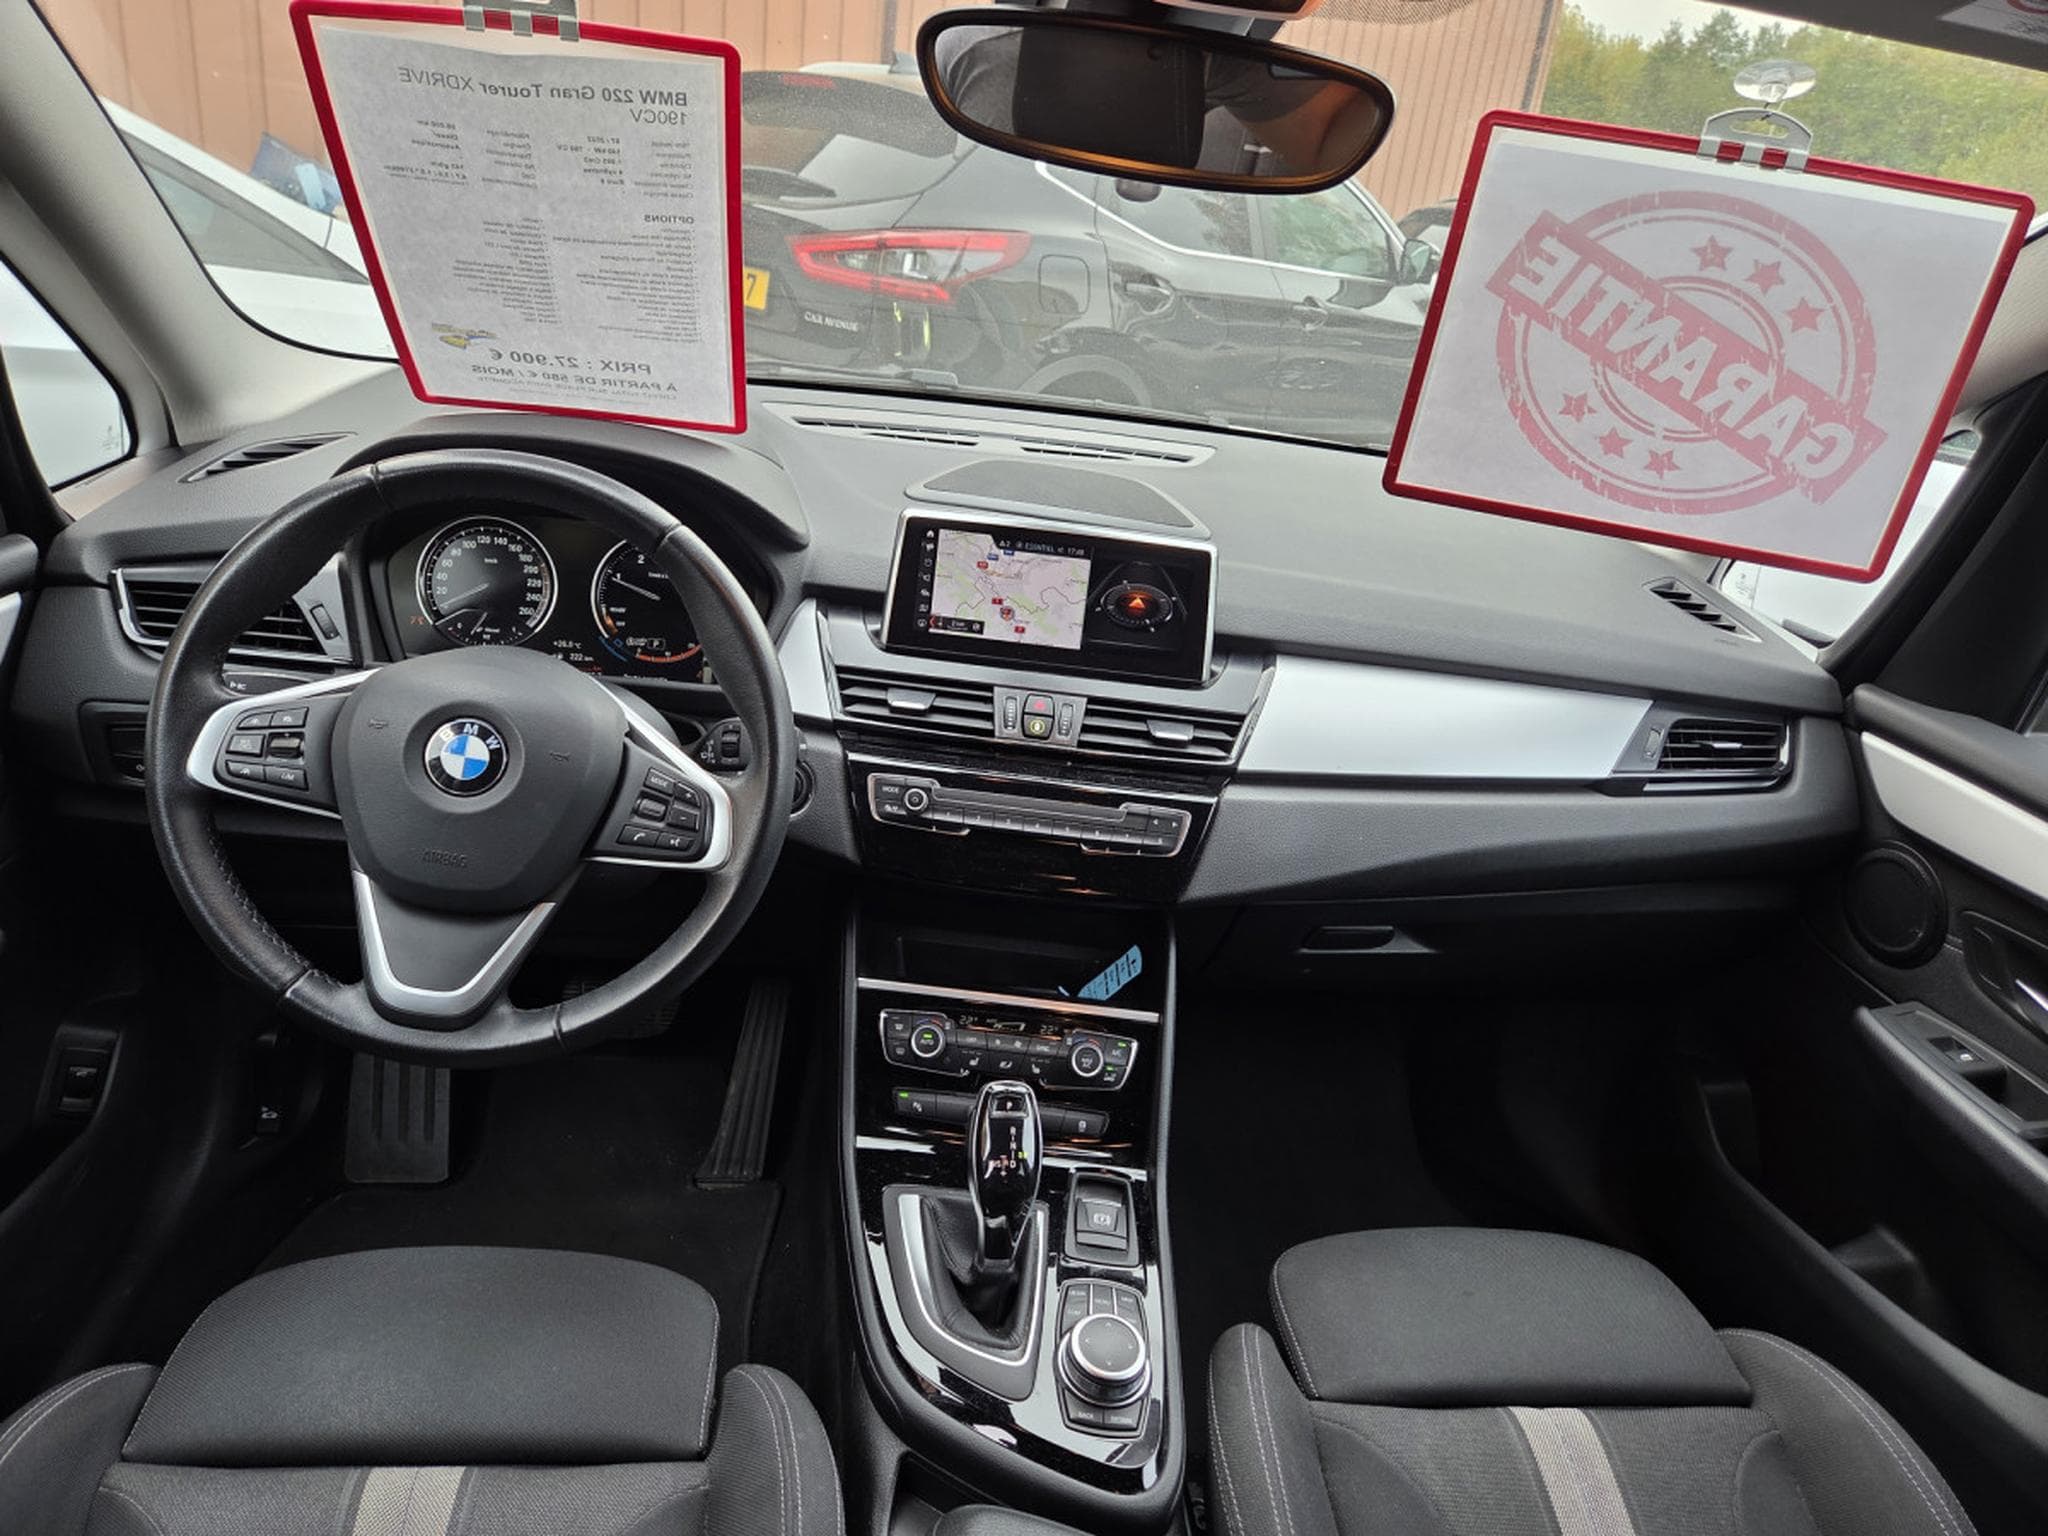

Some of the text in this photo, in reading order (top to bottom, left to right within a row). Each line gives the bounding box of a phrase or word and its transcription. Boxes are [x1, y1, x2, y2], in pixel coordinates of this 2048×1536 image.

[477, 535, 491, 544] 120
[494, 536, 508, 545] 140
[462, 540, 477, 549] 100
[508, 543, 523, 553] 160
[518, 554, 533, 563] 180
[637, 554, 645, 564] 2
[441, 559, 453, 568] 60
[523, 565, 539, 574] 200
[436, 572, 448, 581] 40
[527, 578, 542, 587] 220
[436, 586, 448, 595] 20
[525, 593, 541, 601] 240
[518, 606, 535, 616] 260
[440, 723, 500, 751] BMW
[650, 775, 669, 787] MODE
[882, 786, 899, 794] MODE
